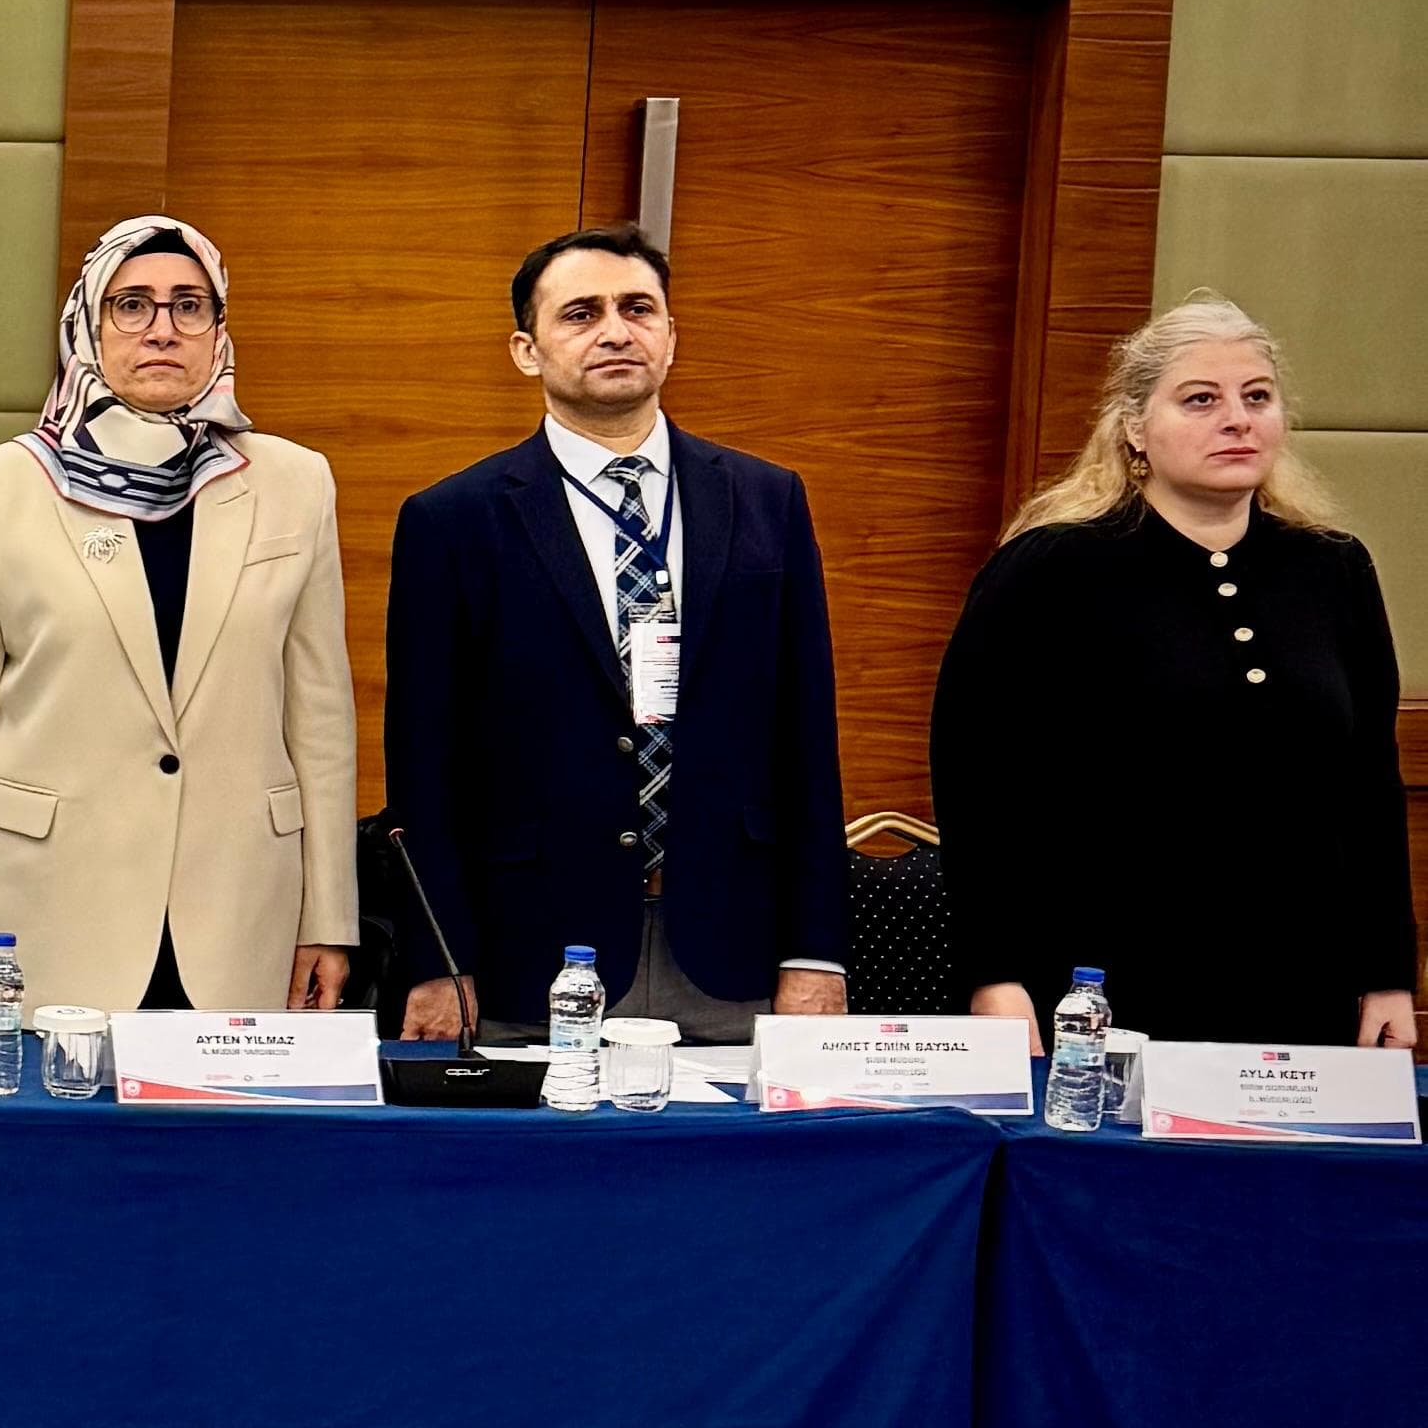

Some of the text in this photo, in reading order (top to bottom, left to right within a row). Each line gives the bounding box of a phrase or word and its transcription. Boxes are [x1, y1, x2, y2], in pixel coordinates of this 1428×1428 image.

[195, 1035, 296, 1046] AYTEN YILMAZ
[821, 1041, 871, 1052] AHMET
[1239, 1069, 1277, 1080] AYLA
